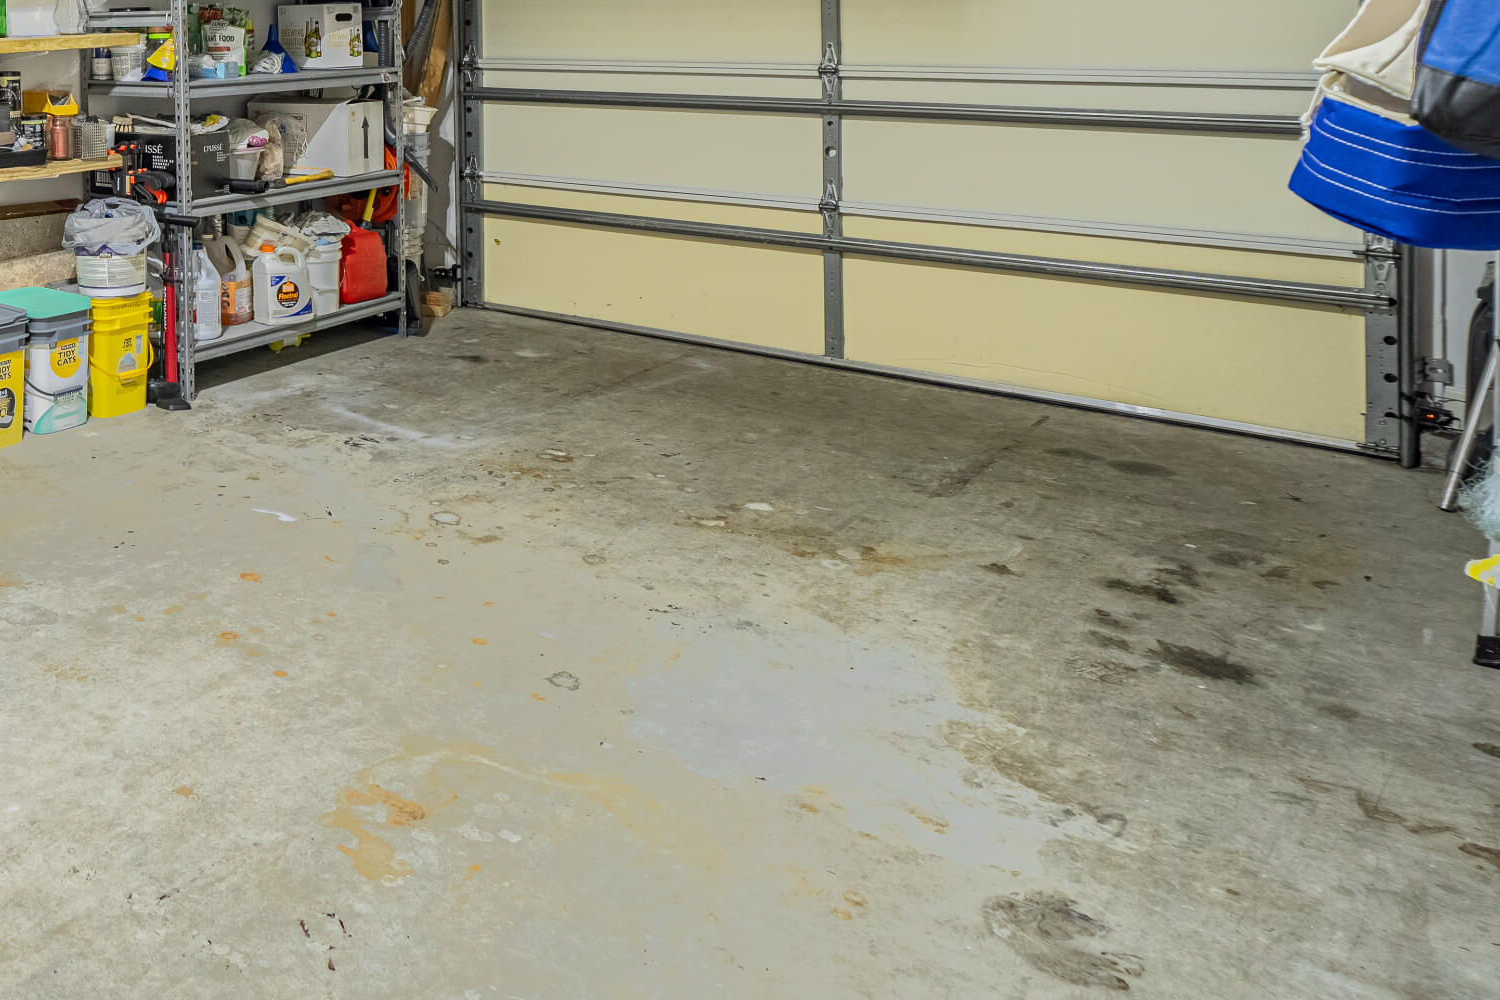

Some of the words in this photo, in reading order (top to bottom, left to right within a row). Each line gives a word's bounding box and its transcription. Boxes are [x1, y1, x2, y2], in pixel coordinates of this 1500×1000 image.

[218, 34, 235, 42] FOOD
[57, 350, 75, 358] TIDY
[57, 357, 77, 366] CATS
